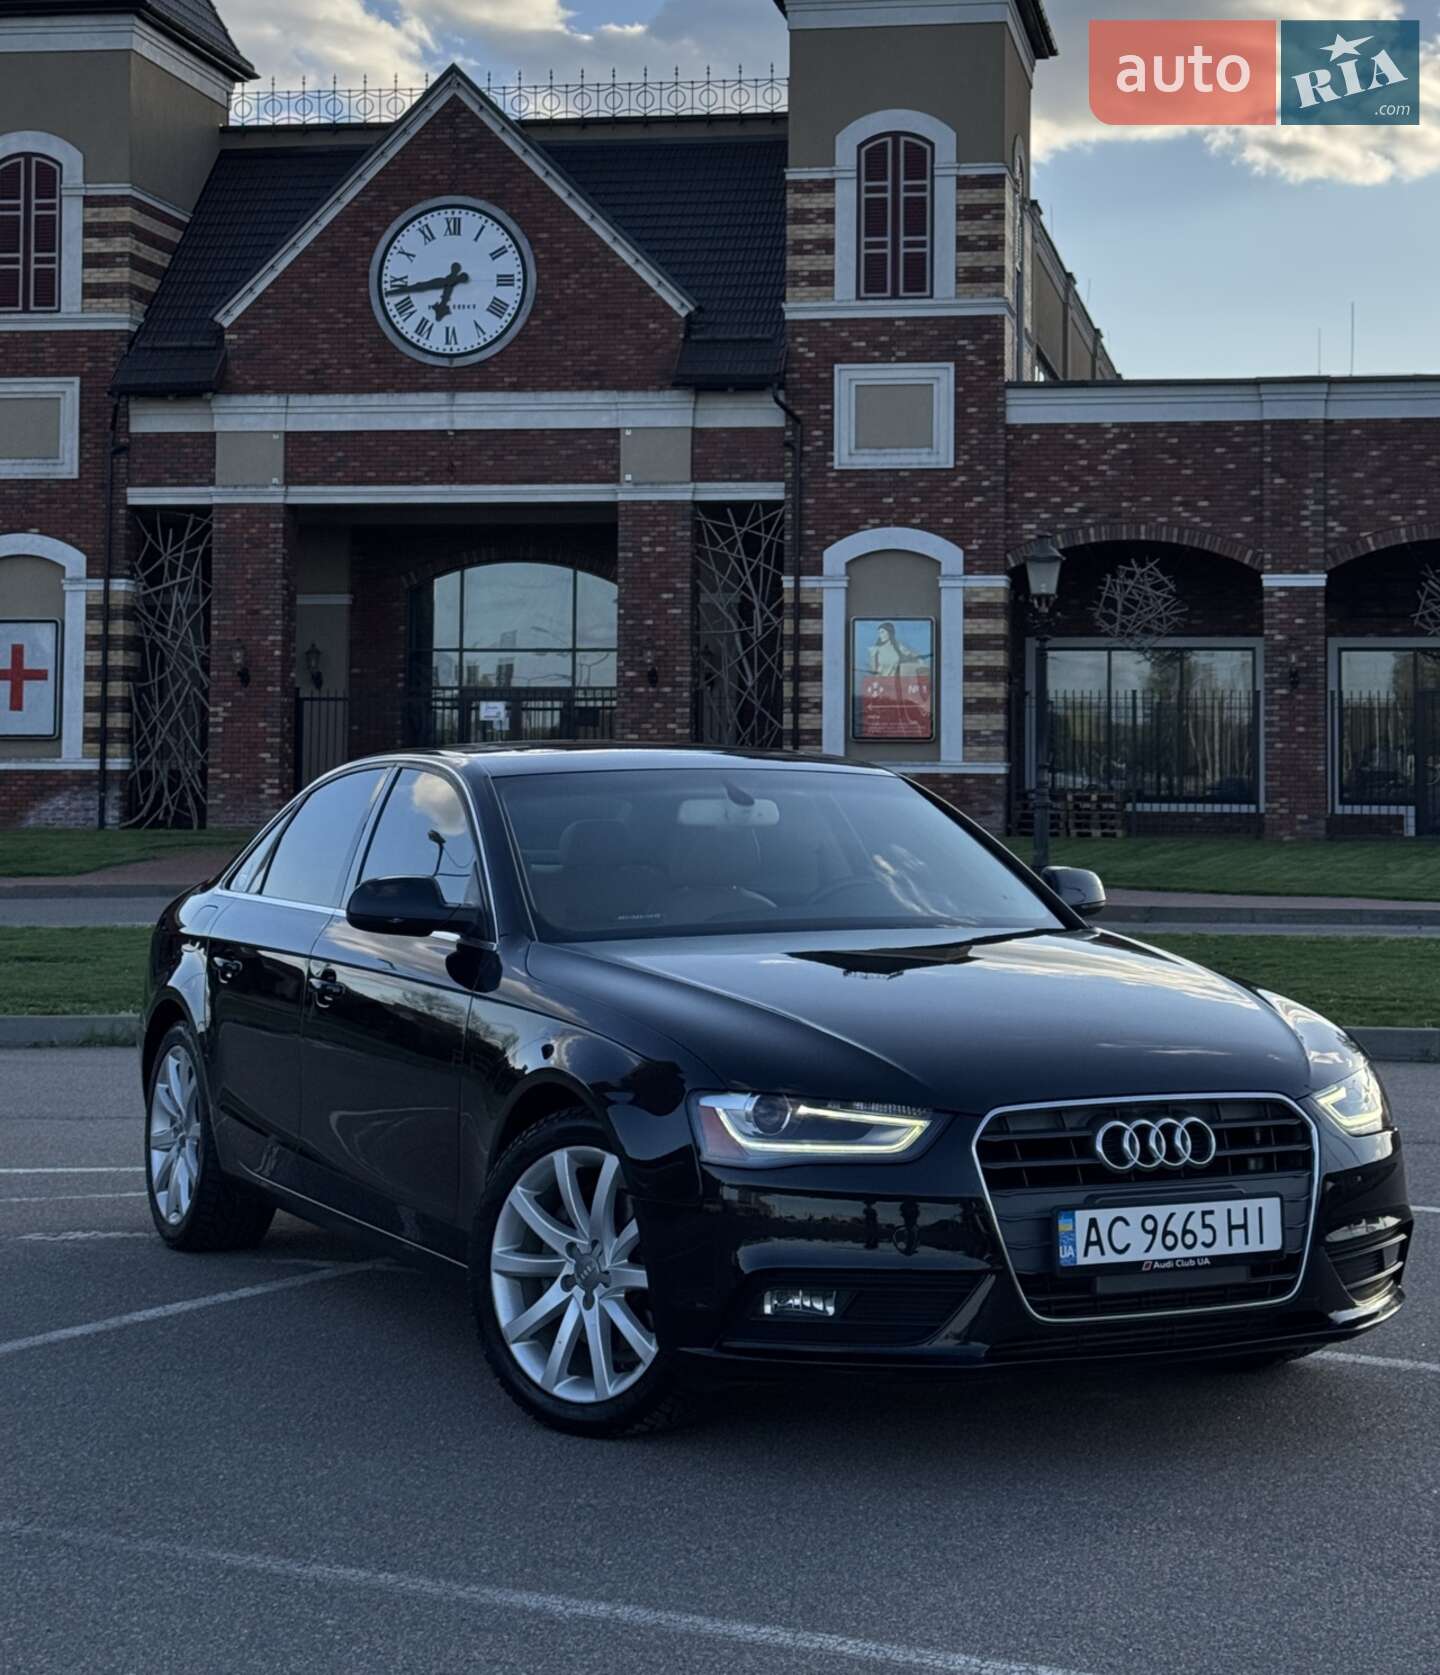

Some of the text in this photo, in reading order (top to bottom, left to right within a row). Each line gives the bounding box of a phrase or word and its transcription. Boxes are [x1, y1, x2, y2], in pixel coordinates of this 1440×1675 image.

[417, 223, 436, 246] XI
[443, 217, 462, 236] XII
[473, 224, 486, 242] I
[397, 247, 416, 263] X
[488, 245, 508, 261] II
[496, 274, 515, 287] III
[394, 296, 417, 322] VIII
[486, 296, 510, 319] IIII
[414, 317, 434, 340] VII
[445, 326, 458, 345] VI
[473, 320, 486, 338] V
[1083, 1206, 1264, 1257] AC 9665 HI
[1059, 1246, 1076, 1259] UA
[1153, 1258, 1210, 1269] Audi Club UA
